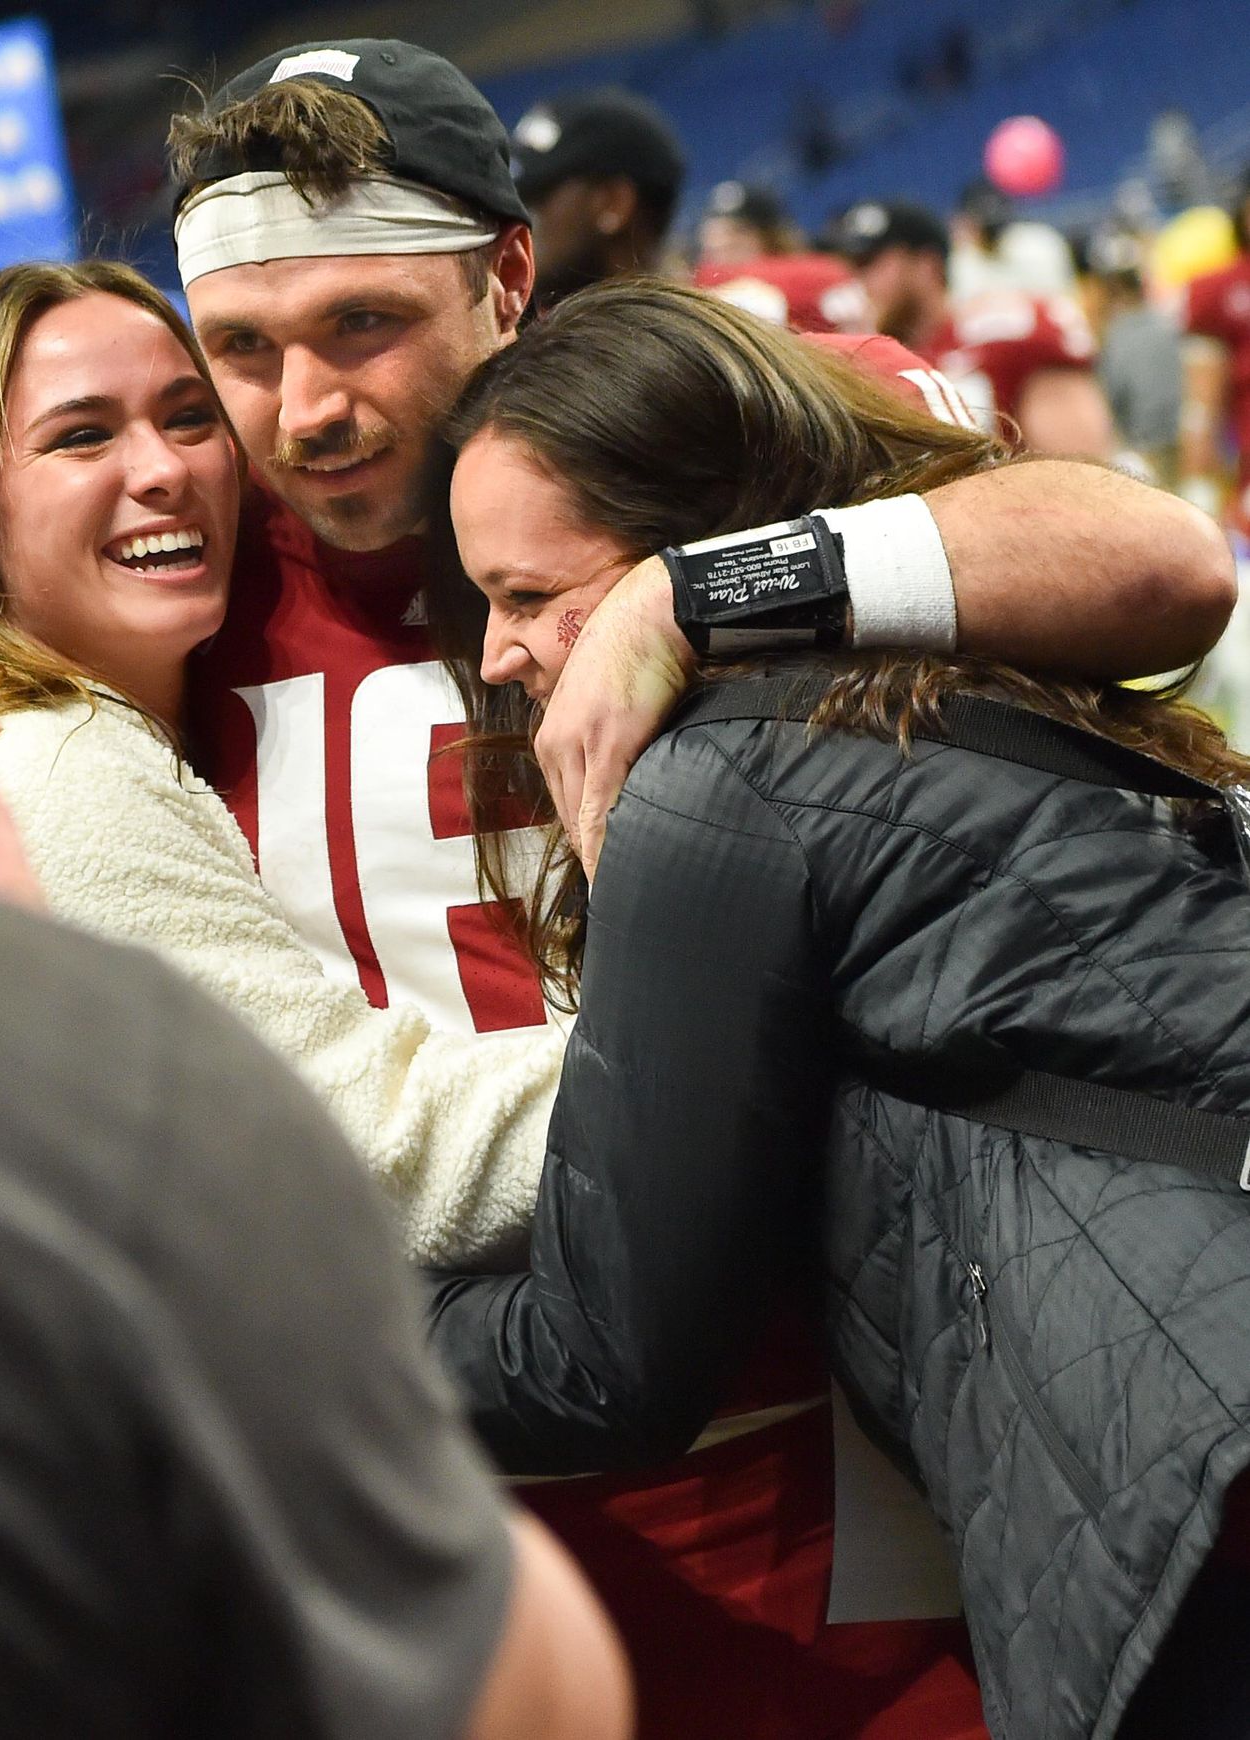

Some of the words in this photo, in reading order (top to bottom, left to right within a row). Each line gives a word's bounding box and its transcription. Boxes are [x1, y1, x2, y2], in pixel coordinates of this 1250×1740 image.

[776, 542, 789, 552] 16
[792, 537, 810, 549] FB
[713, 560, 738, 568] Texas
[763, 557, 789, 567] Phone
[790, 561, 810, 570] Lone
[742, 570, 771, 581] Athletic
[772, 566, 789, 575] Star
[706, 576, 741, 588] Designs,
[753, 573, 800, 595] Wrist
[708, 582, 750, 604] Plan
